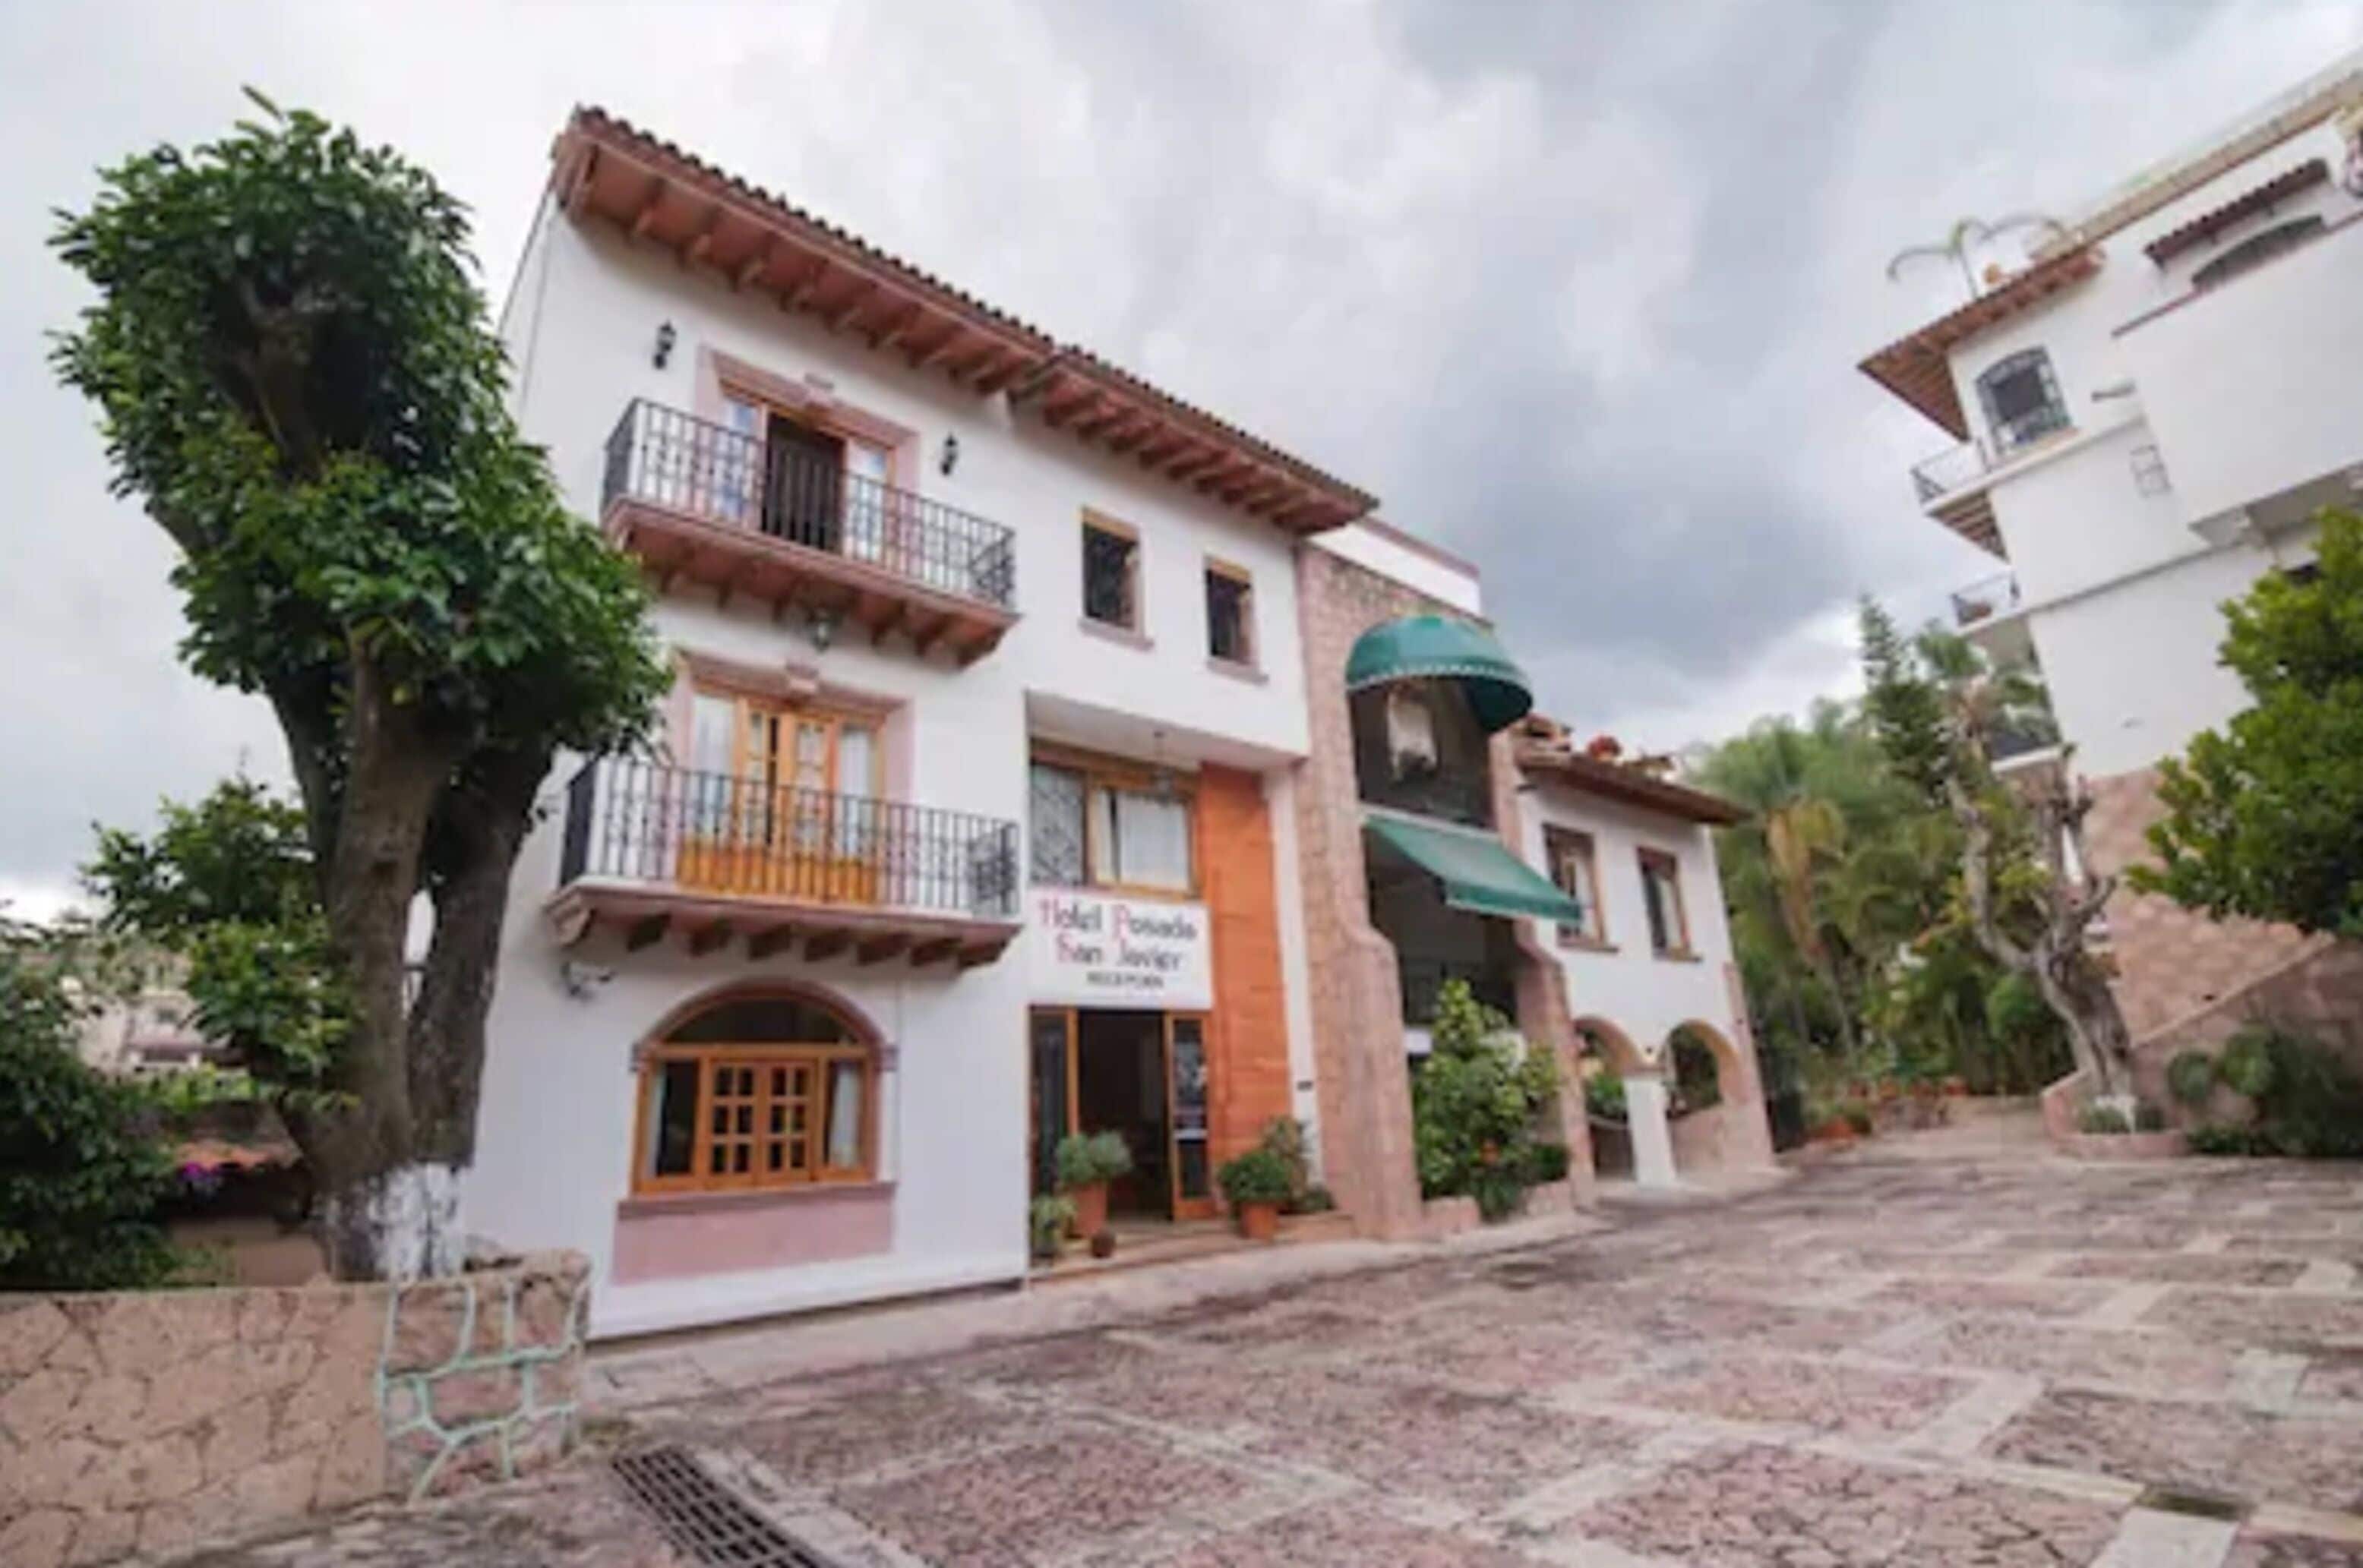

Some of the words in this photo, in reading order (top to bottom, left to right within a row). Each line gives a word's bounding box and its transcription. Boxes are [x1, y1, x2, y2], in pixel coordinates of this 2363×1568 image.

[1040, 898, 1102, 932] Hotel
[1113, 904, 1197, 941] Posada
[1057, 933, 1102, 964] San
[1117, 938, 1181, 970] Javier
